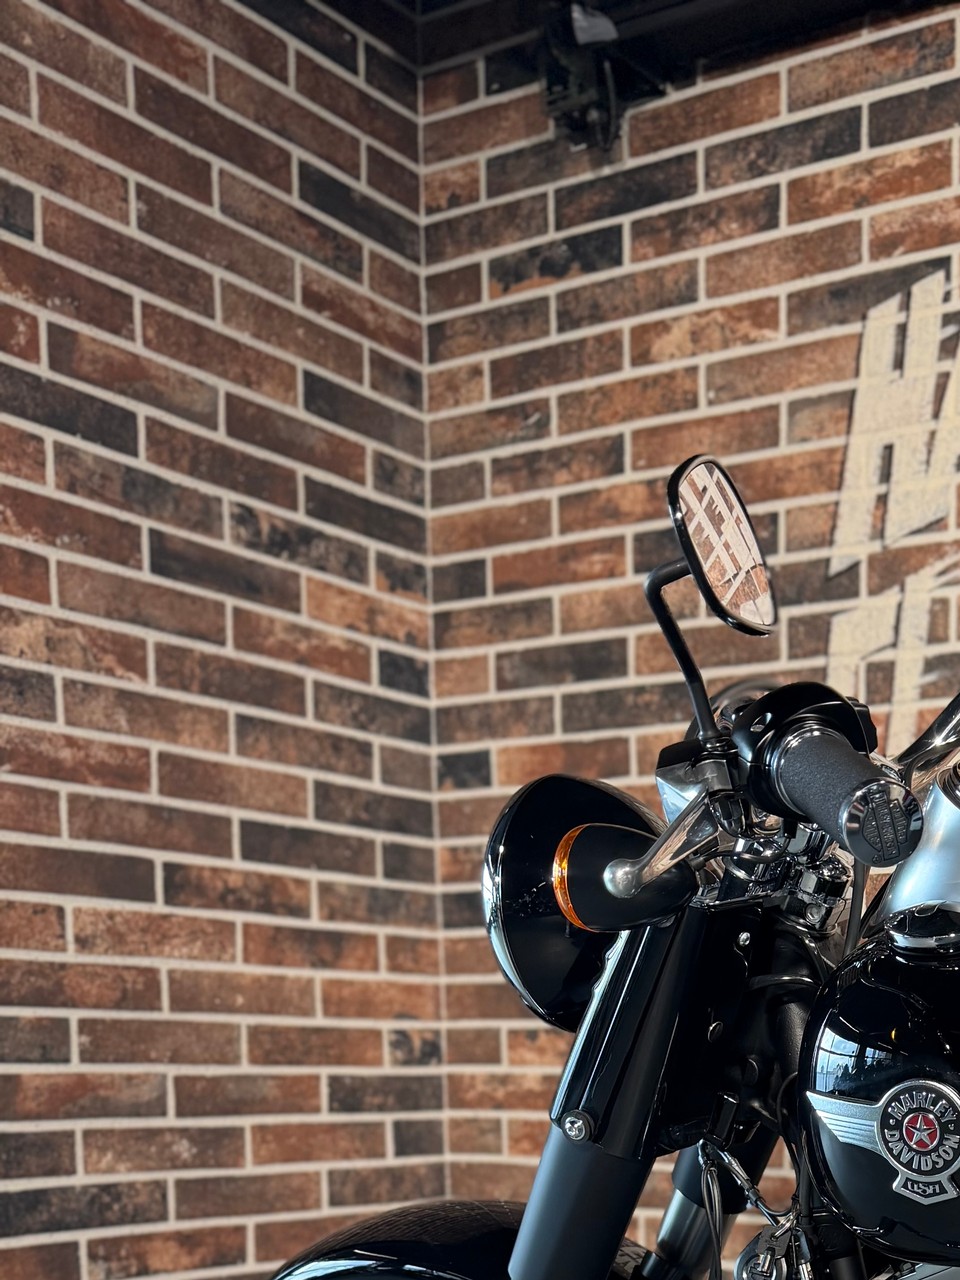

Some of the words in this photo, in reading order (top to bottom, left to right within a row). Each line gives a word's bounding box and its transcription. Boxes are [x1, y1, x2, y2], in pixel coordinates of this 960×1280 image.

[888, 1091, 957, 1123] HARLEY
[885, 1129, 960, 1172] DAVIDSON
[907, 1182, 940, 1195] USA
